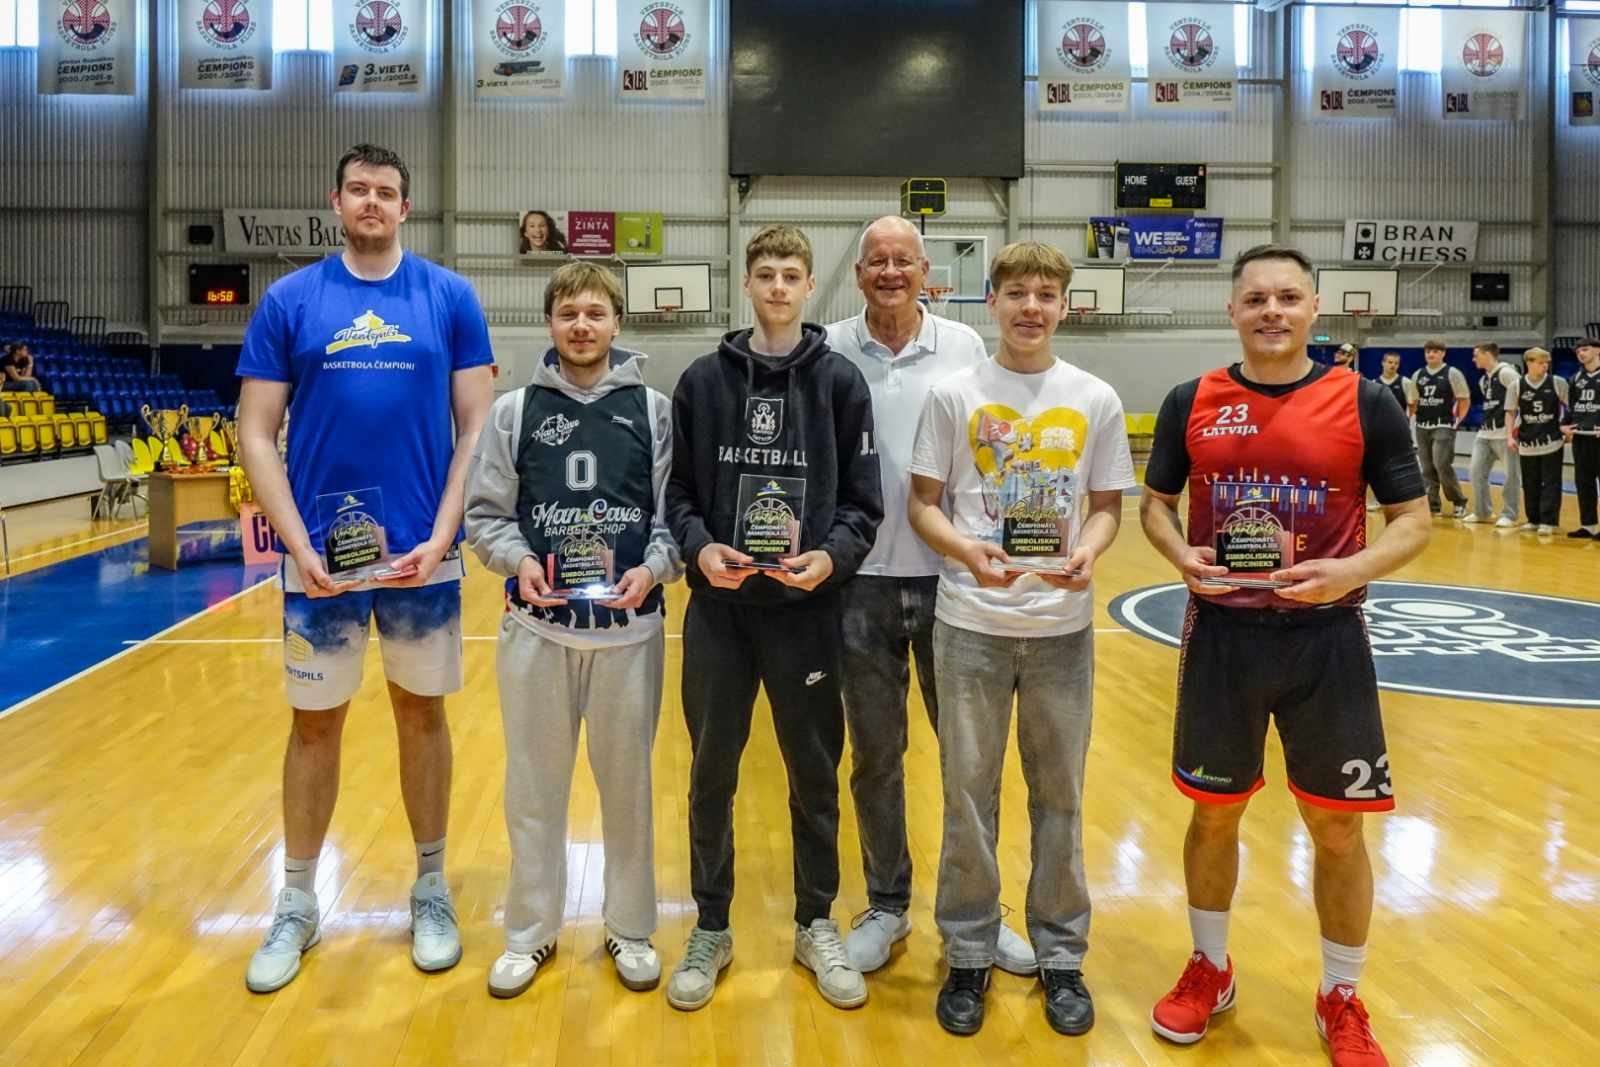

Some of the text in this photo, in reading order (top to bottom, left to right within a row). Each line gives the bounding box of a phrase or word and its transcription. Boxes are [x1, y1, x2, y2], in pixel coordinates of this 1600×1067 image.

[640, 1, 684, 16] VENTSPILS
[1062, 17, 1105, 31] VENTSPILS
[1169, 17, 1212, 31] VENTSPILS
[1337, 23, 1378, 37] VENTSPILS
[57, 20, 117, 51] BASKETBOLA KLUBS
[196, 20, 257, 50] BASKETBOLA KLUBS
[349, 24, 408, 54] BASKETBOLA KLUBS
[490, 30, 548, 58] BASKETBOLA KLUBS
[633, 32, 691, 61] BASKETBOLA KLUBS
[1056, 47, 1112, 74] BASKETBOLA KLUBS
[1164, 46, 1219, 73] BASKETBOLA KLUBS
[1331, 53, 1385, 80] BASKETBOLA KLUBS
[650, 68, 703, 78] ČEMPIONS
[1073, 82, 1124, 91] ČEMPIONS
[1183, 81, 1232, 89] ČEMPIONS
[1347, 88, 1396, 97] ČEMPIONS
[1124, 175, 1198, 186] HOME GUEST
[238, 215, 302, 246] VENTAS
[575, 220, 609, 230] ZINTA
[1134, 231, 1163, 246] WE
[1384, 225, 1454, 242] BRAN
[1134, 245, 1187, 254] #MOBAPP
[1382, 245, 1467, 262] CHESS
[207, 290, 234, 302] 16:58
[334, 325, 398, 348] Ventspils
[323, 360, 415, 370] BASKETBOLA ČEMPIONI
[1424, 385, 1437, 396] 17
[1580, 389, 1595, 401] 10
[1215, 403, 1249, 425] 23
[1533, 401, 1543, 412] 5
[532, 419, 580, 441] Man Cave
[1202, 425, 1258, 437] LATVIJA
[565, 450, 597, 491] 0
[532, 499, 643, 529] Man Cave
[544, 524, 626, 537] BARBER SHOP
[1202, 774, 1232, 784] VENTSPILS
[1341, 753, 1393, 798] 23
